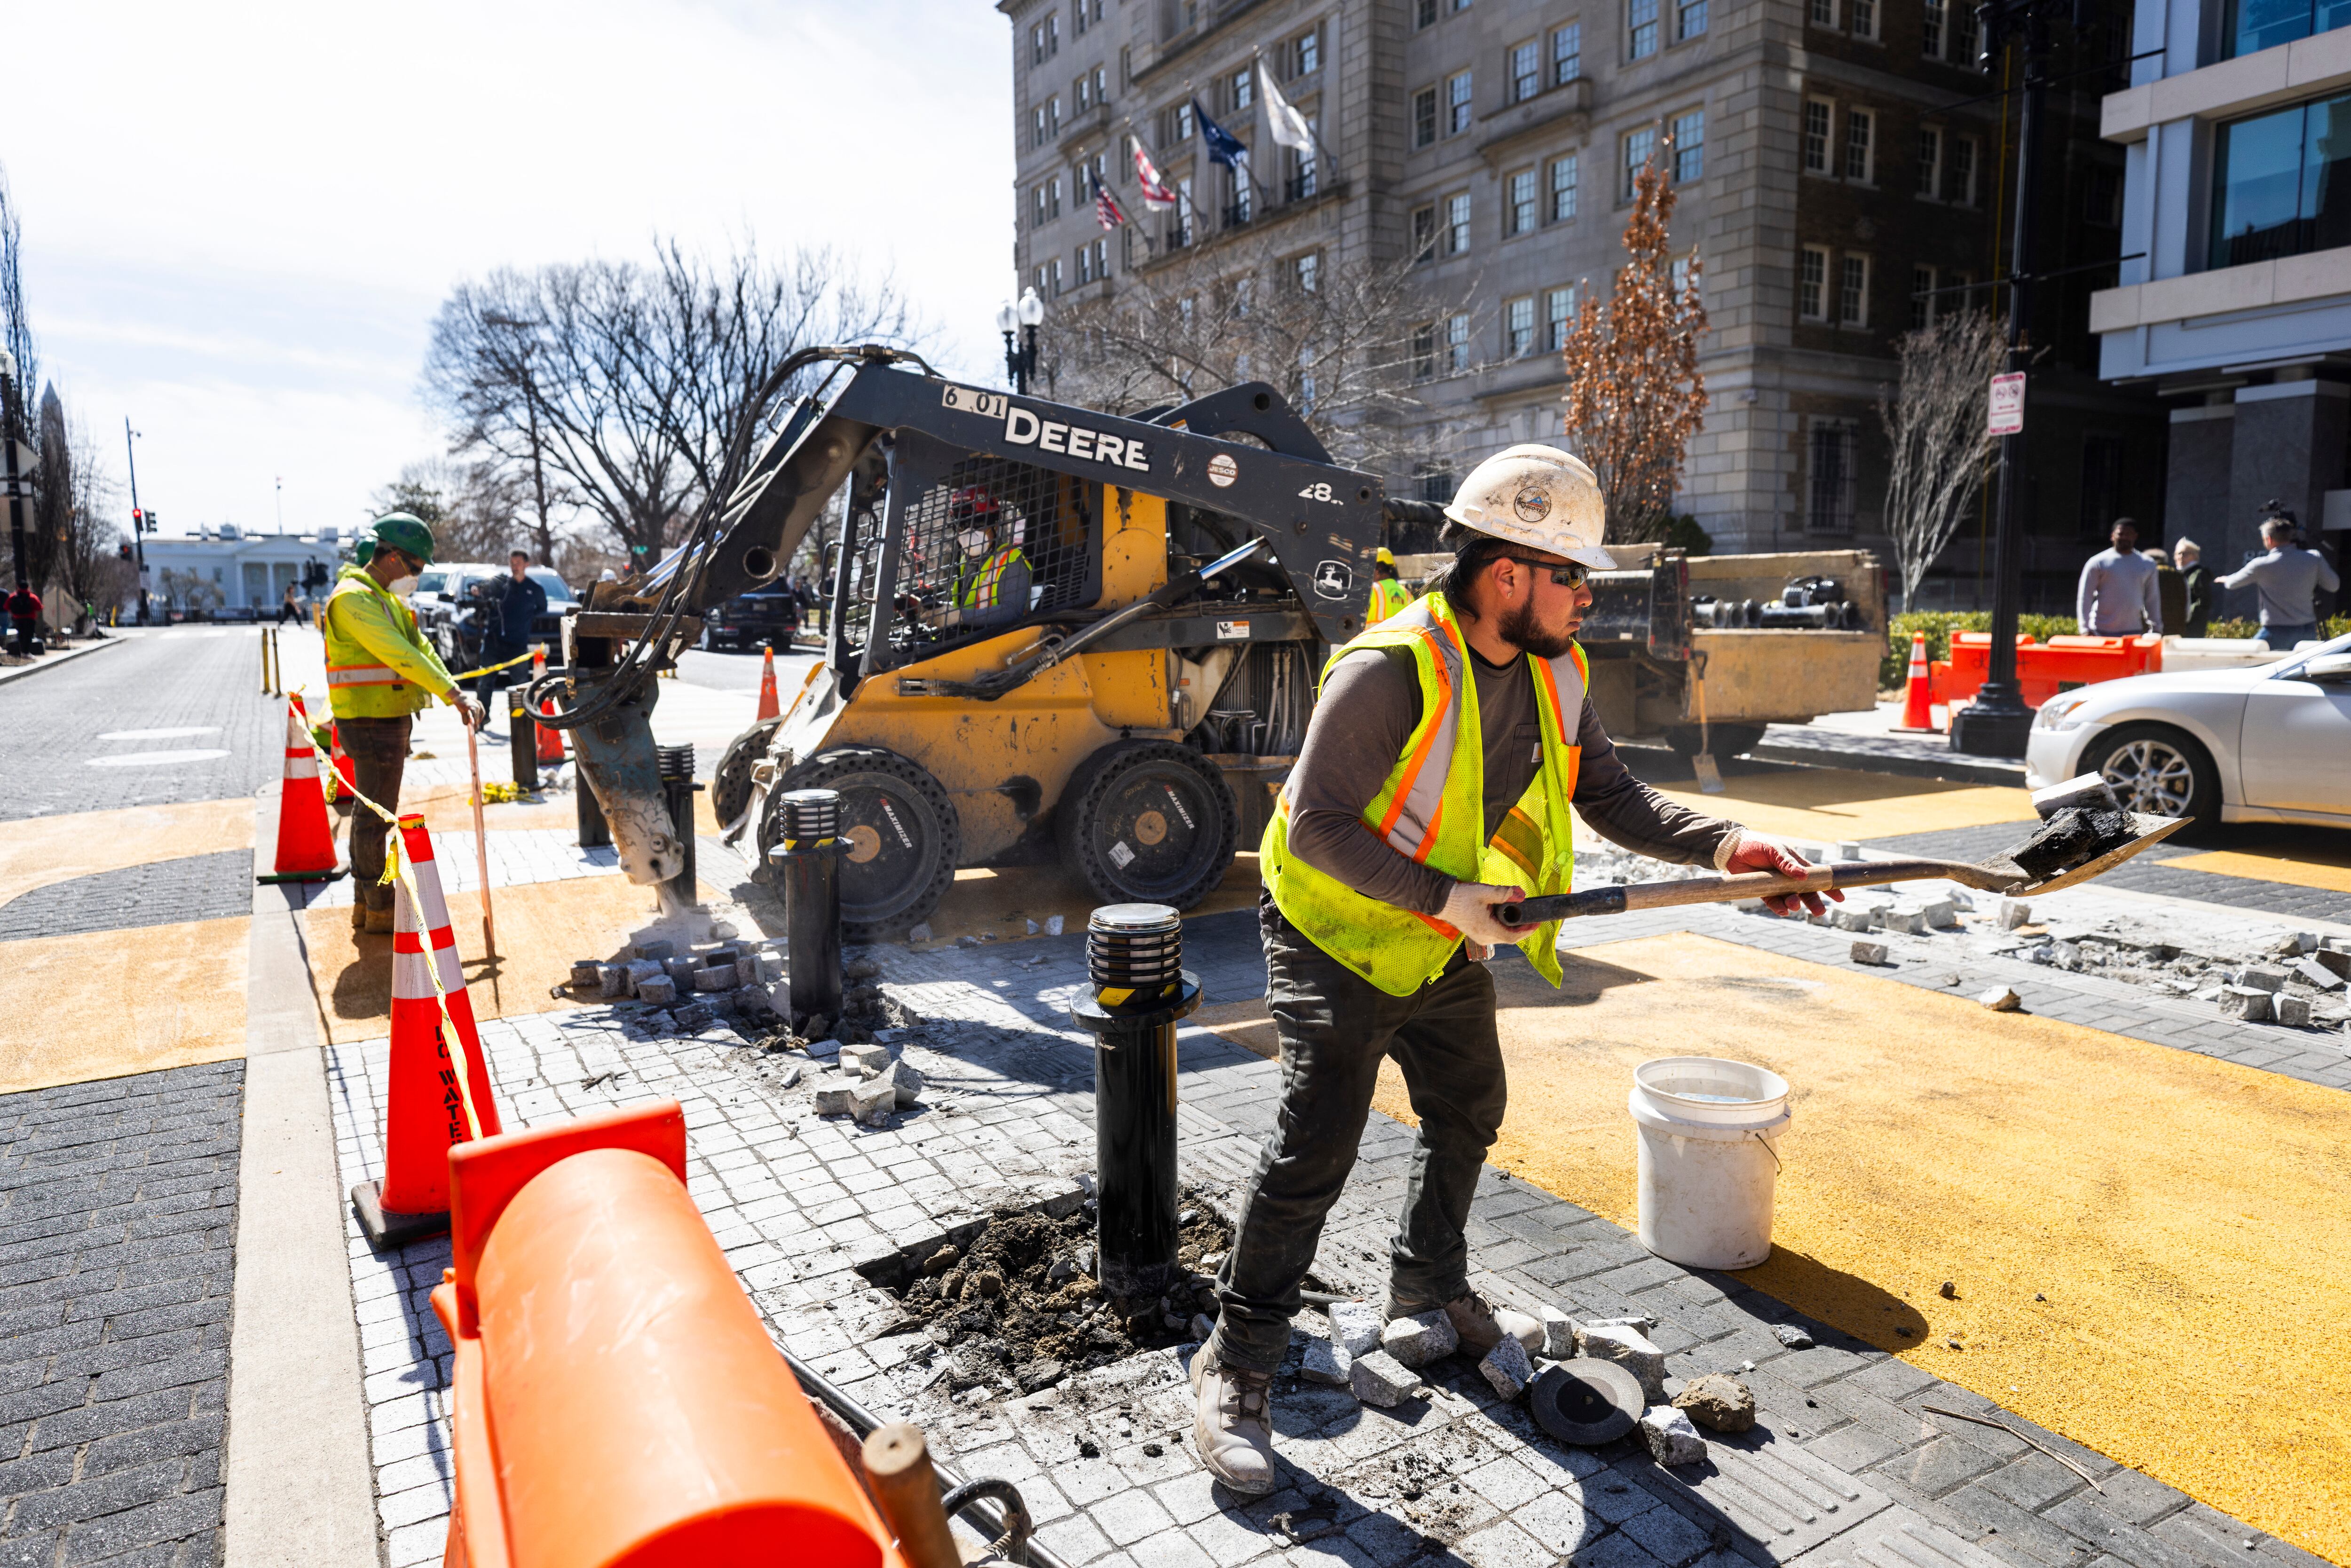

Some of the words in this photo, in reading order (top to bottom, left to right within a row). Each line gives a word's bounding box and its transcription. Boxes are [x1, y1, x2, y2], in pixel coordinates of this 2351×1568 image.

[1005, 407, 1149, 471] DEERE
[1209, 466, 1236, 476] JESCO
[884, 805, 912, 848] MAXIMIZER
[1168, 791, 1195, 829] MAXIMIZER
